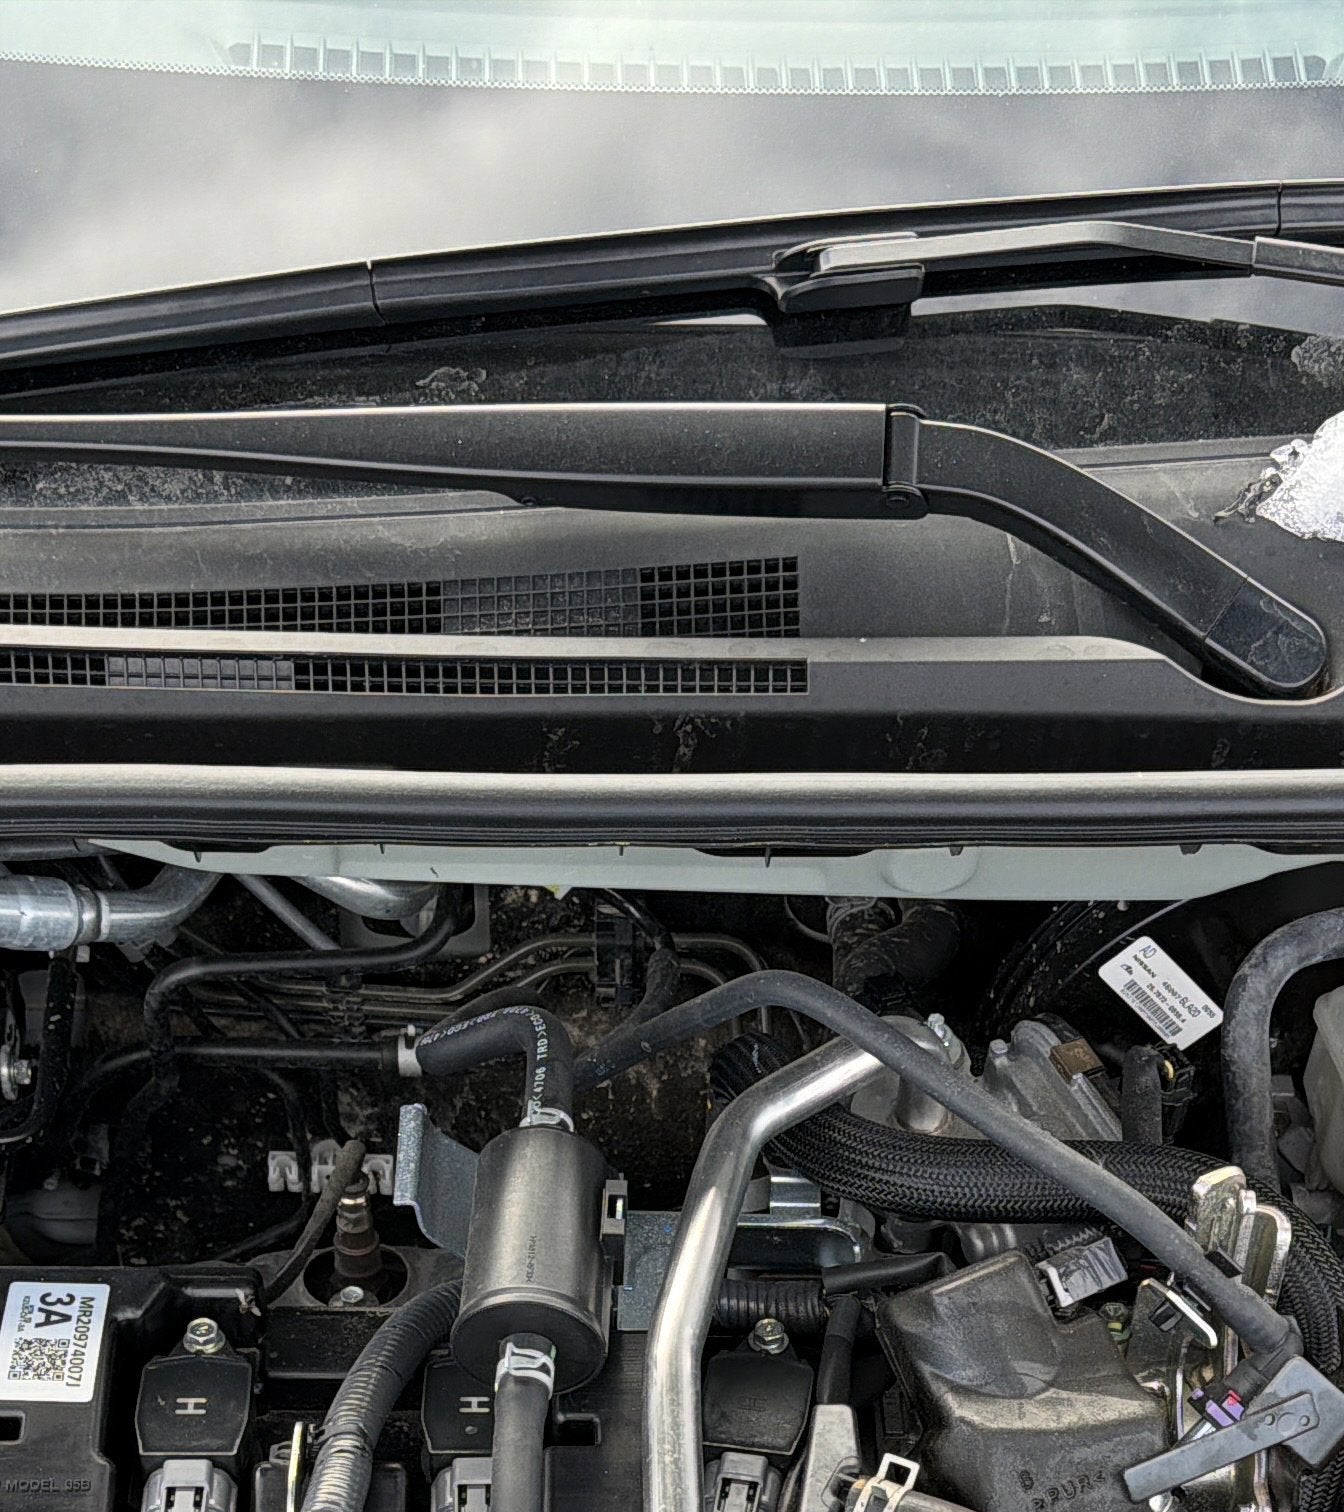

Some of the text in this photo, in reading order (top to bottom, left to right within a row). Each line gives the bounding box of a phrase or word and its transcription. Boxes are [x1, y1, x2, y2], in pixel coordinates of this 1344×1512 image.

[1132, 954, 1157, 978] NISSAN
[34, 1291, 76, 1328] 3A
[6, 1478, 60, 1493] MODEL
